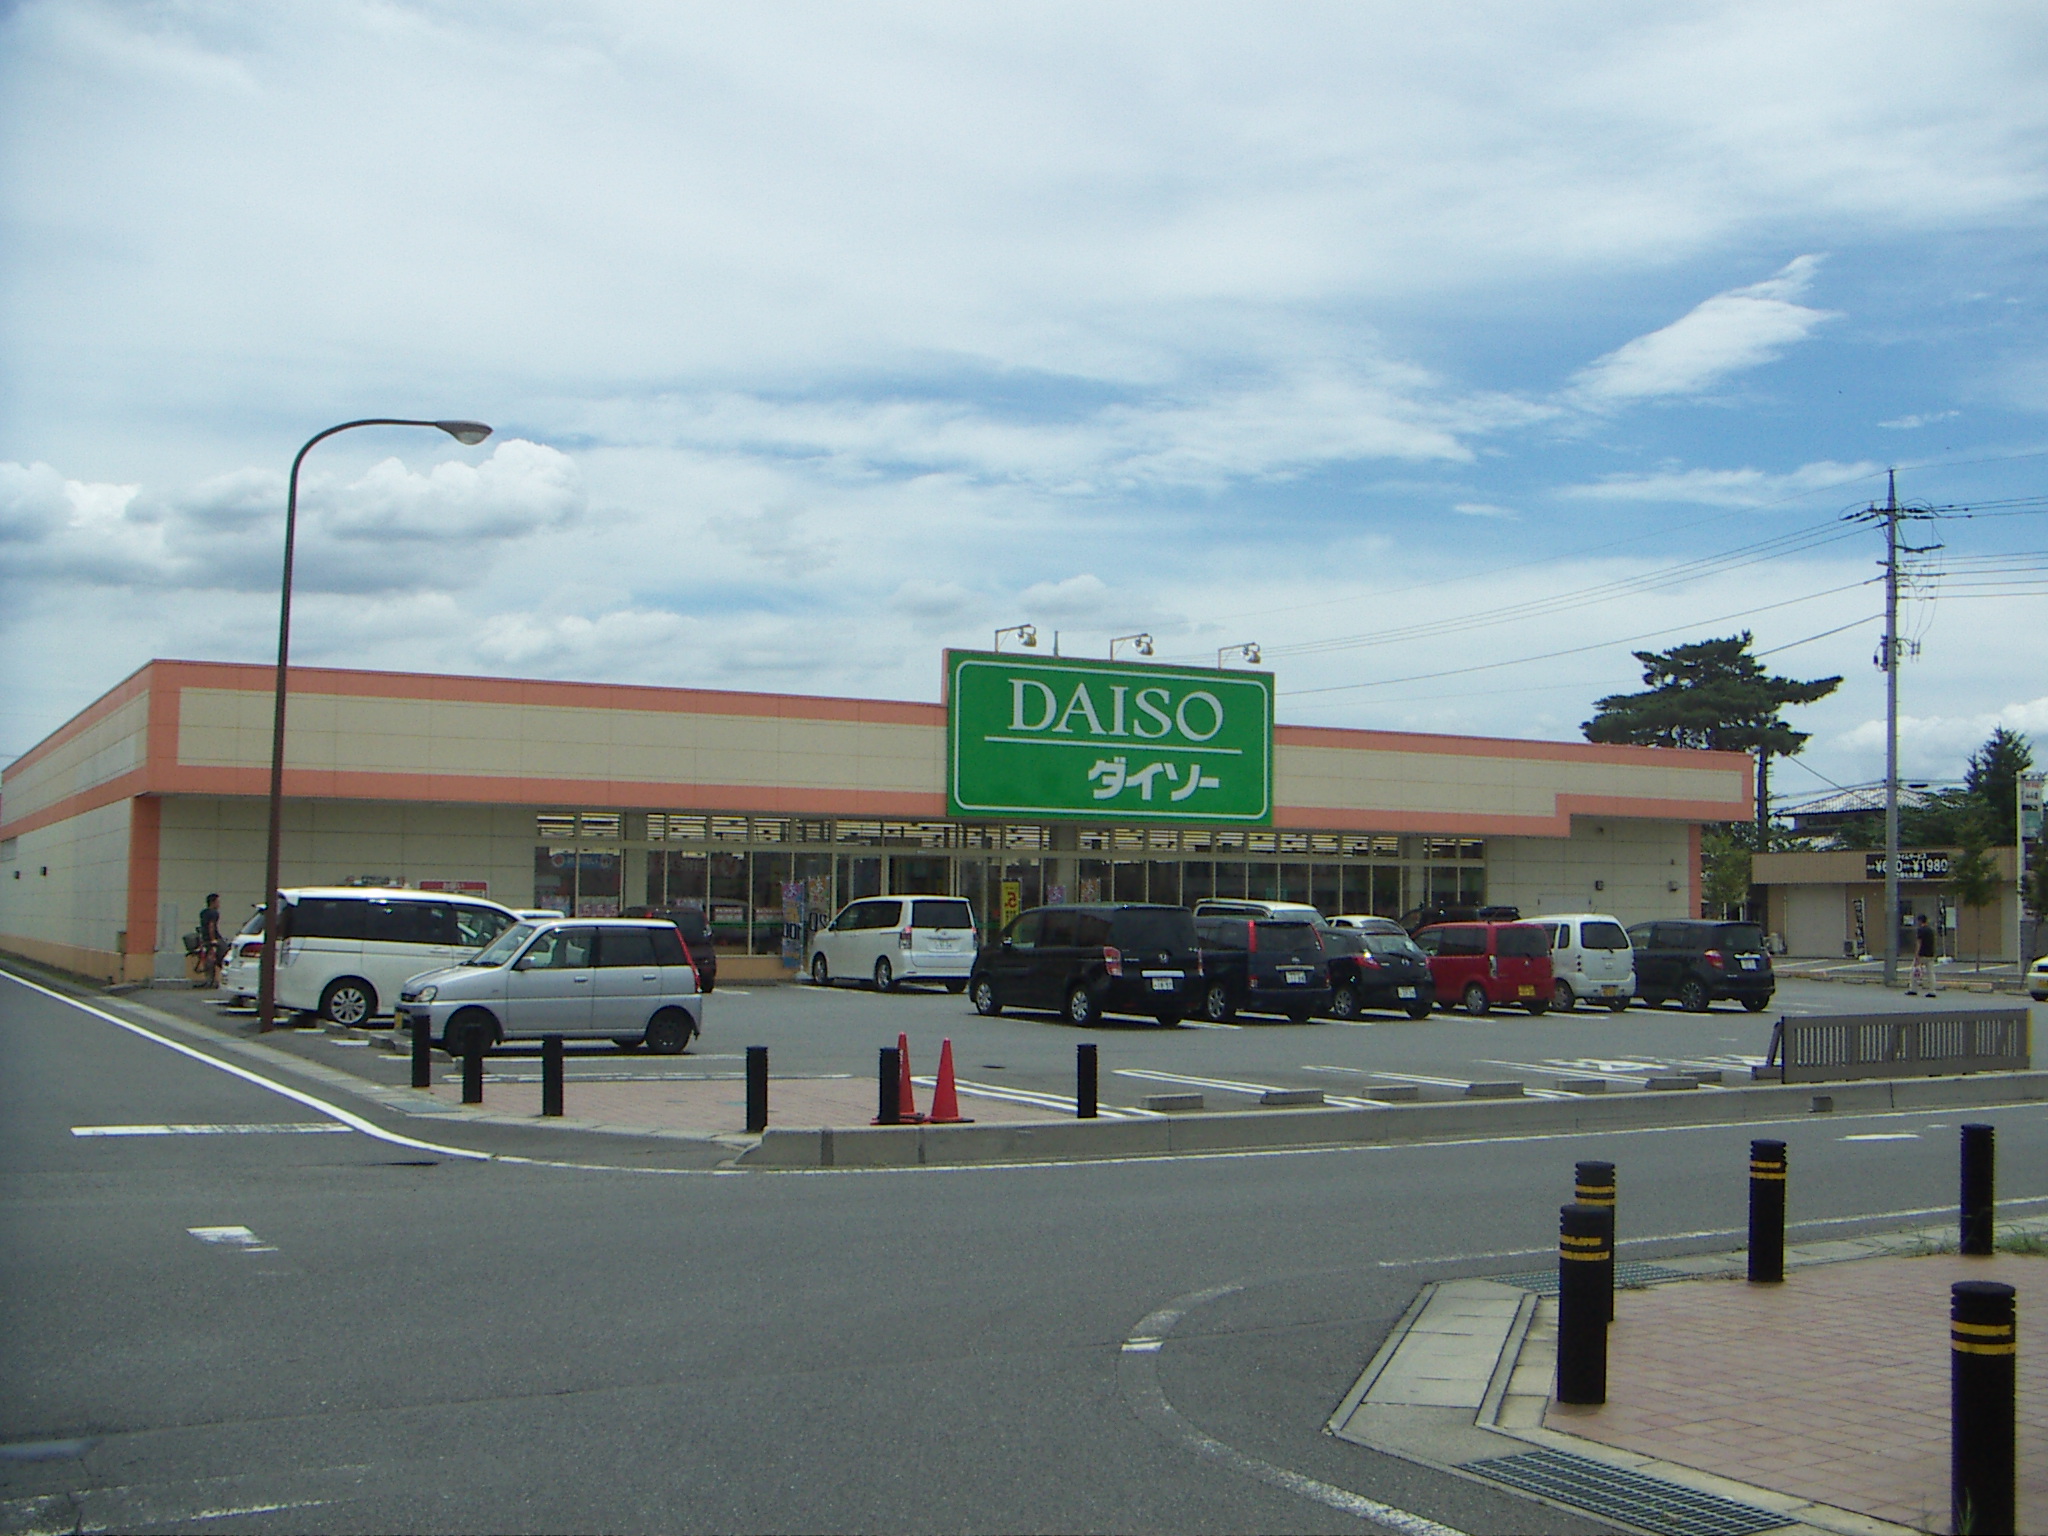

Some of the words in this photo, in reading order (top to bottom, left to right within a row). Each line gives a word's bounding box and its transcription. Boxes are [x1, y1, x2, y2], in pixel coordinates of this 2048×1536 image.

[1008, 678, 1223, 742] DAISO
[1088, 756, 1219, 801] ダイソー
[1912, 858, 1948, 872] ¥1980
